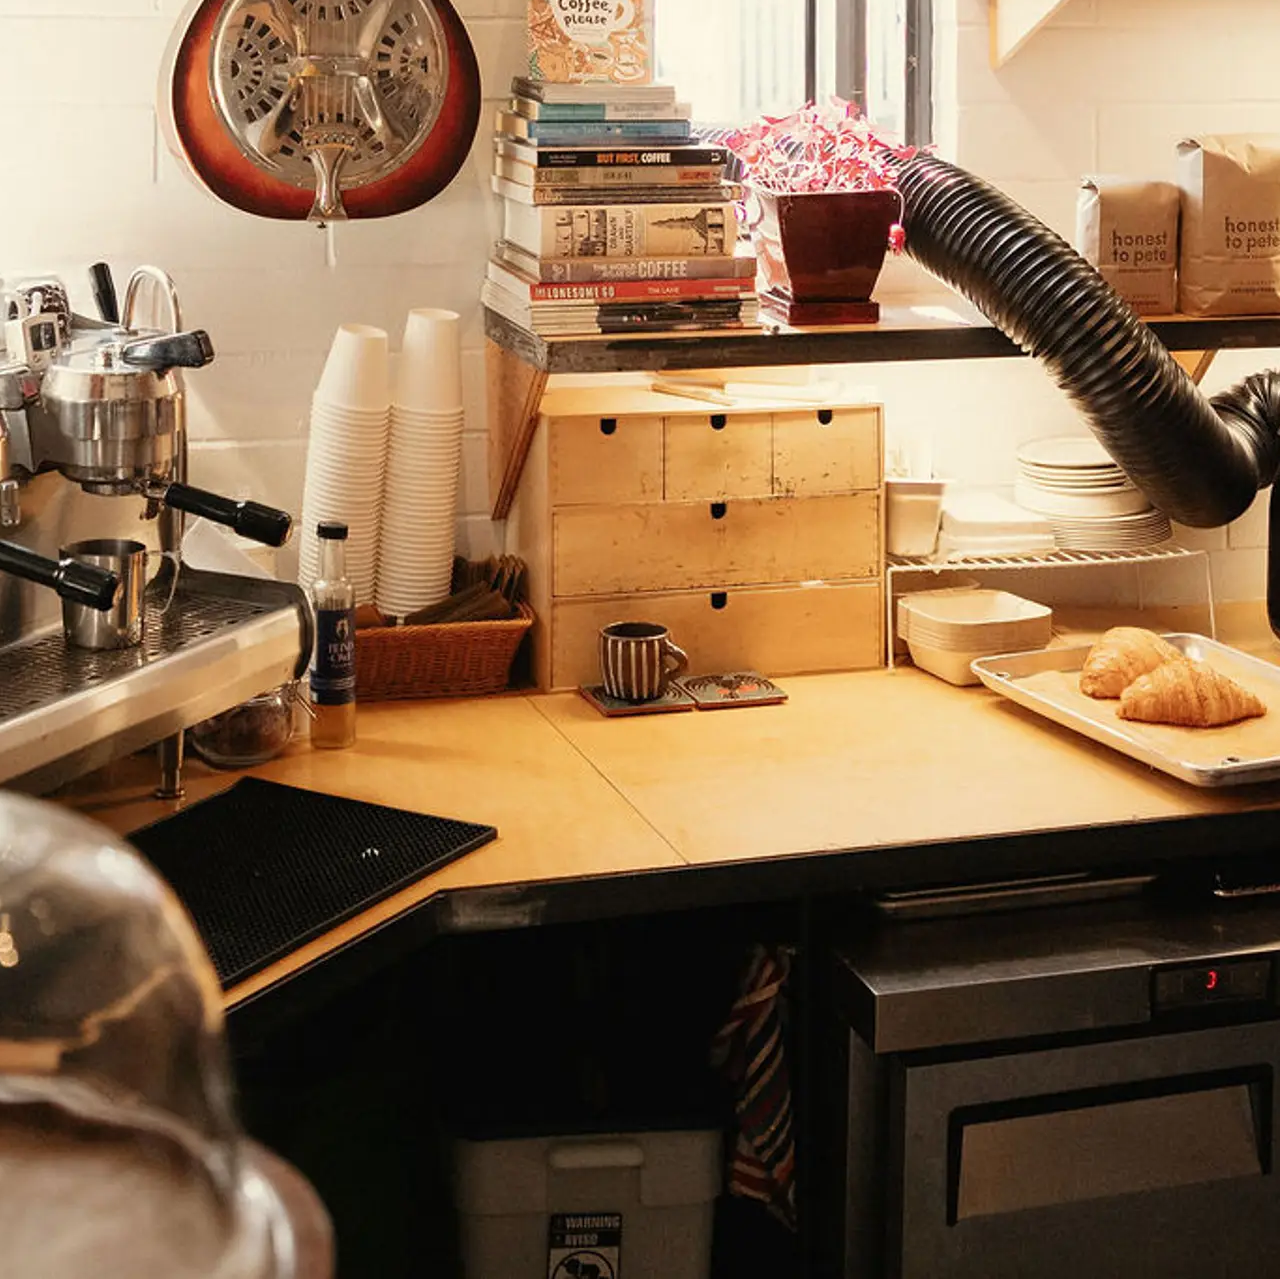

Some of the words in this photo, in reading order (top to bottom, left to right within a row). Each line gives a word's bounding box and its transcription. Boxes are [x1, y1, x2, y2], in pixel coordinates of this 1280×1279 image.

[563, 14, 607, 28] please
[596, 152, 613, 163] BUT
[641, 152, 671, 163] COFFEE
[609, 217, 617, 249] DRAWN
[624, 208, 634, 257] QUARTERLY
[1224, 216, 1280, 233] honest
[1112, 228, 1167, 246] honest
[1225, 235, 1242, 249] to
[1246, 233, 1280, 253] pete
[1113, 248, 1129, 262] to
[1133, 247, 1166, 266] pete
[638, 260, 688, 278] COFFEE
[547, 287, 599, 298] LONESOME
[601, 286, 615, 298] GO
[1206, 971, 1217, 989] 3
[565, 1216, 620, 1229] WARNING
[565, 1233, 598, 1246] AVISO
